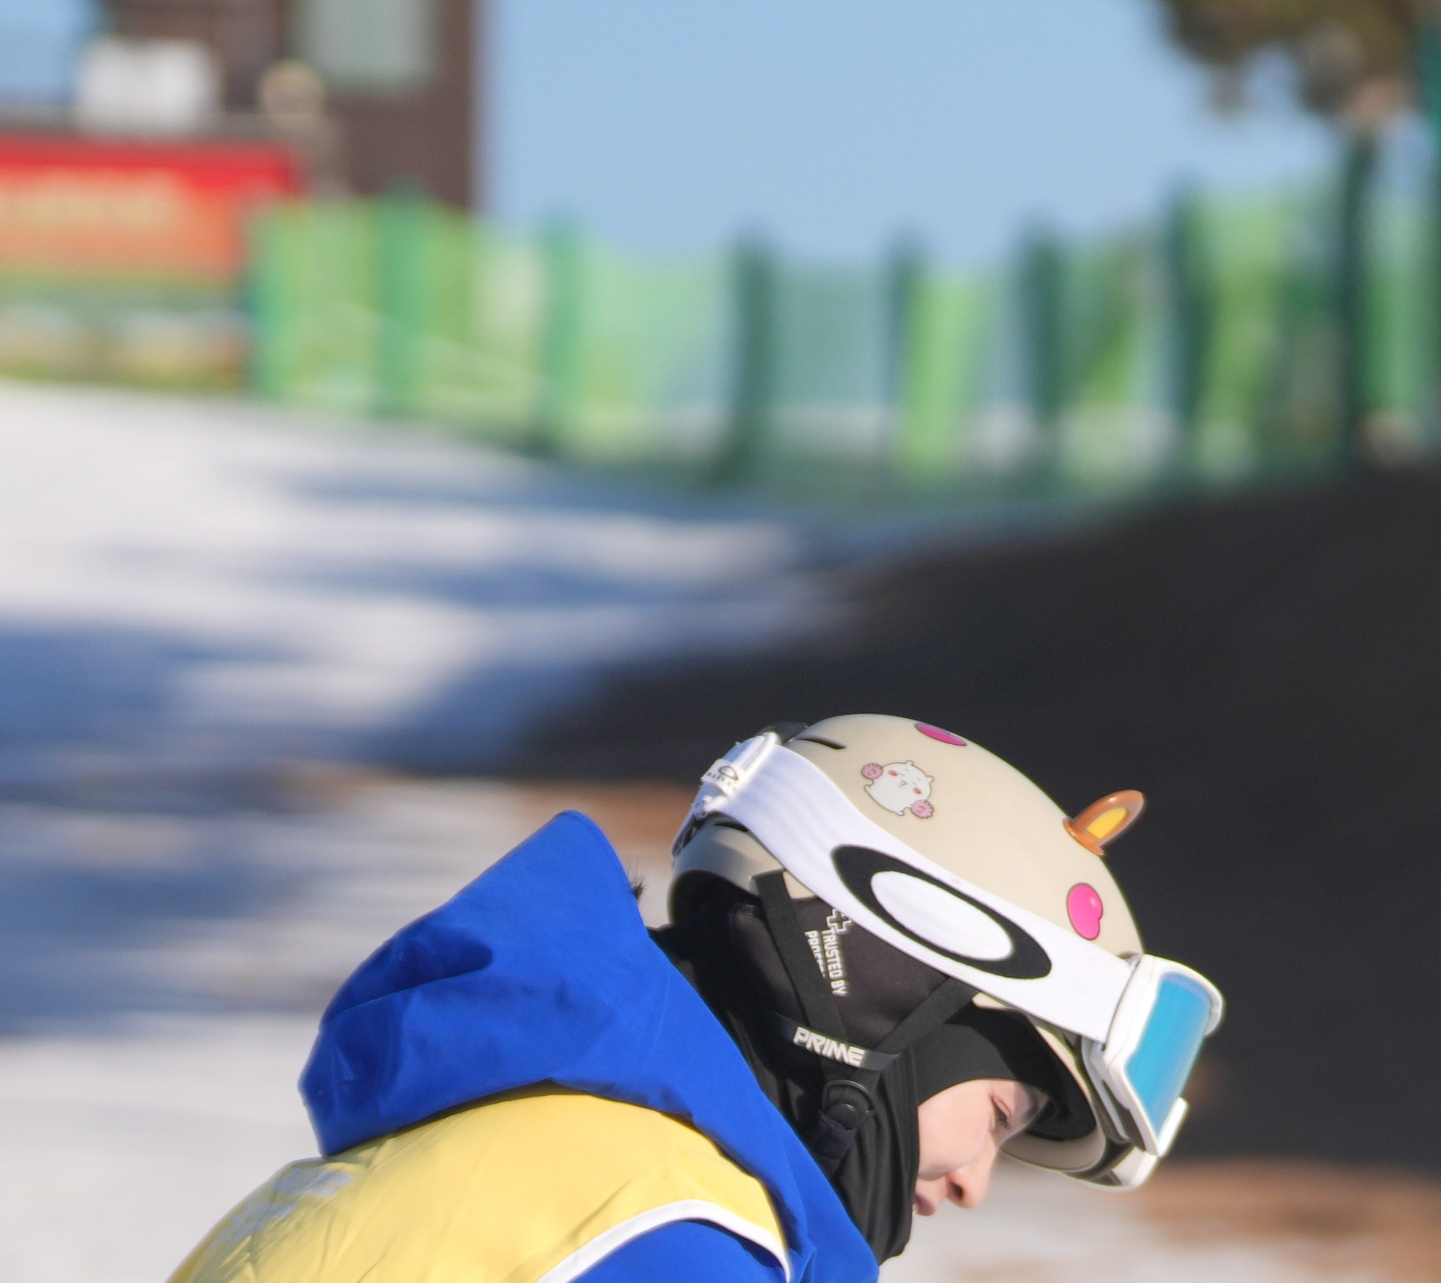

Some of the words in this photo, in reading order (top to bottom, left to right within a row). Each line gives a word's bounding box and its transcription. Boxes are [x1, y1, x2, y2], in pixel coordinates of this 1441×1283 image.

[821, 928, 844, 979] TRUSTED
[830, 979, 849, 997] BY
[792, 1026, 866, 1069] PRIME
